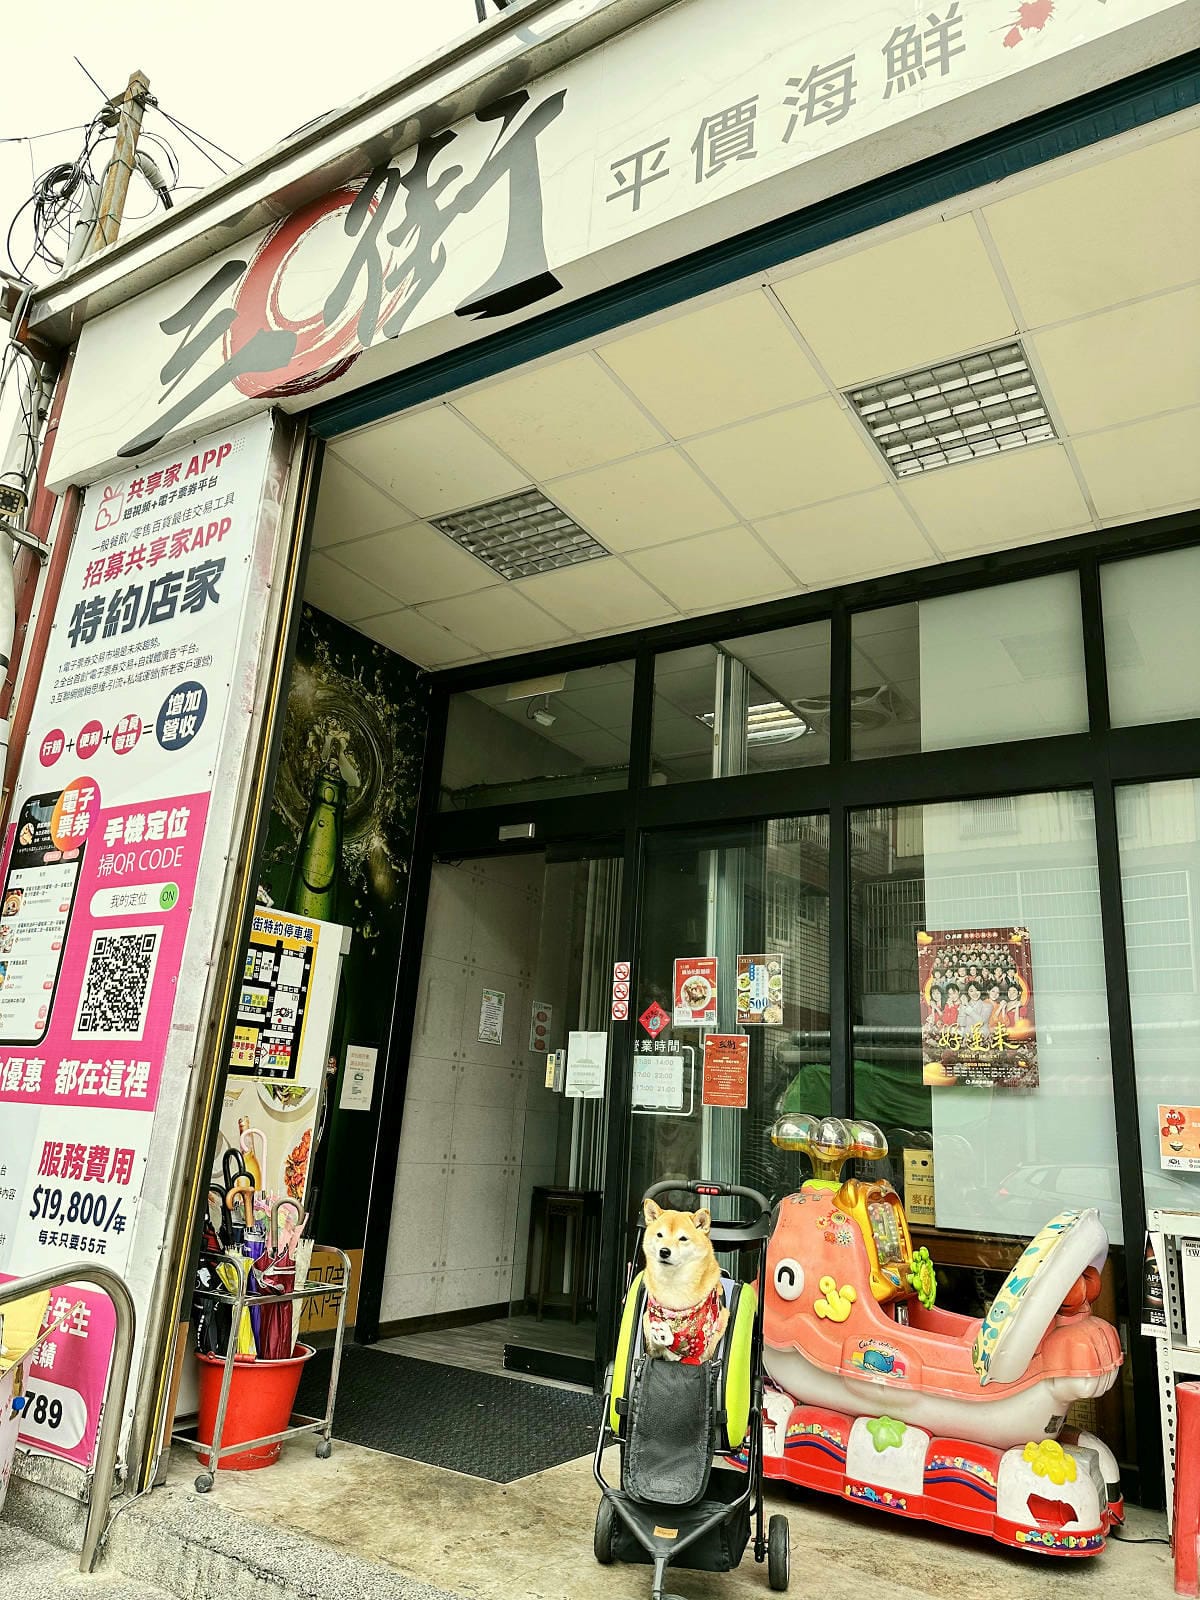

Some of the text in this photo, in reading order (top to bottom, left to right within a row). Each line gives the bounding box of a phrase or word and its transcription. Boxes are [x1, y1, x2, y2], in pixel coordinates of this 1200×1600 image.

[605, 1, 967, 212] 平價海鮮
[126, 442, 233, 504] 共享家 APP
[82, 517, 233, 590] 招募共享家APP
[67, 556, 227, 649] 特約店家
[165, 688, 203, 717] 增加
[160, 713, 198, 743] 營收
[61, 786, 96, 814] 電子
[55, 811, 91, 840] 票券
[102, 806, 191, 849] 手機定位
[138, 845, 185, 873] CODE
[160, 887, 176, 902] ON
[0, 1056, 152, 1099] 優惠 都在這裡
[37, 1140, 136, 1186] 服務費用
[29, 1183, 127, 1237] $19,800/年
[38, 1228, 108, 1256] 每天只要55元
[21, 1390, 64, 1430] 789
